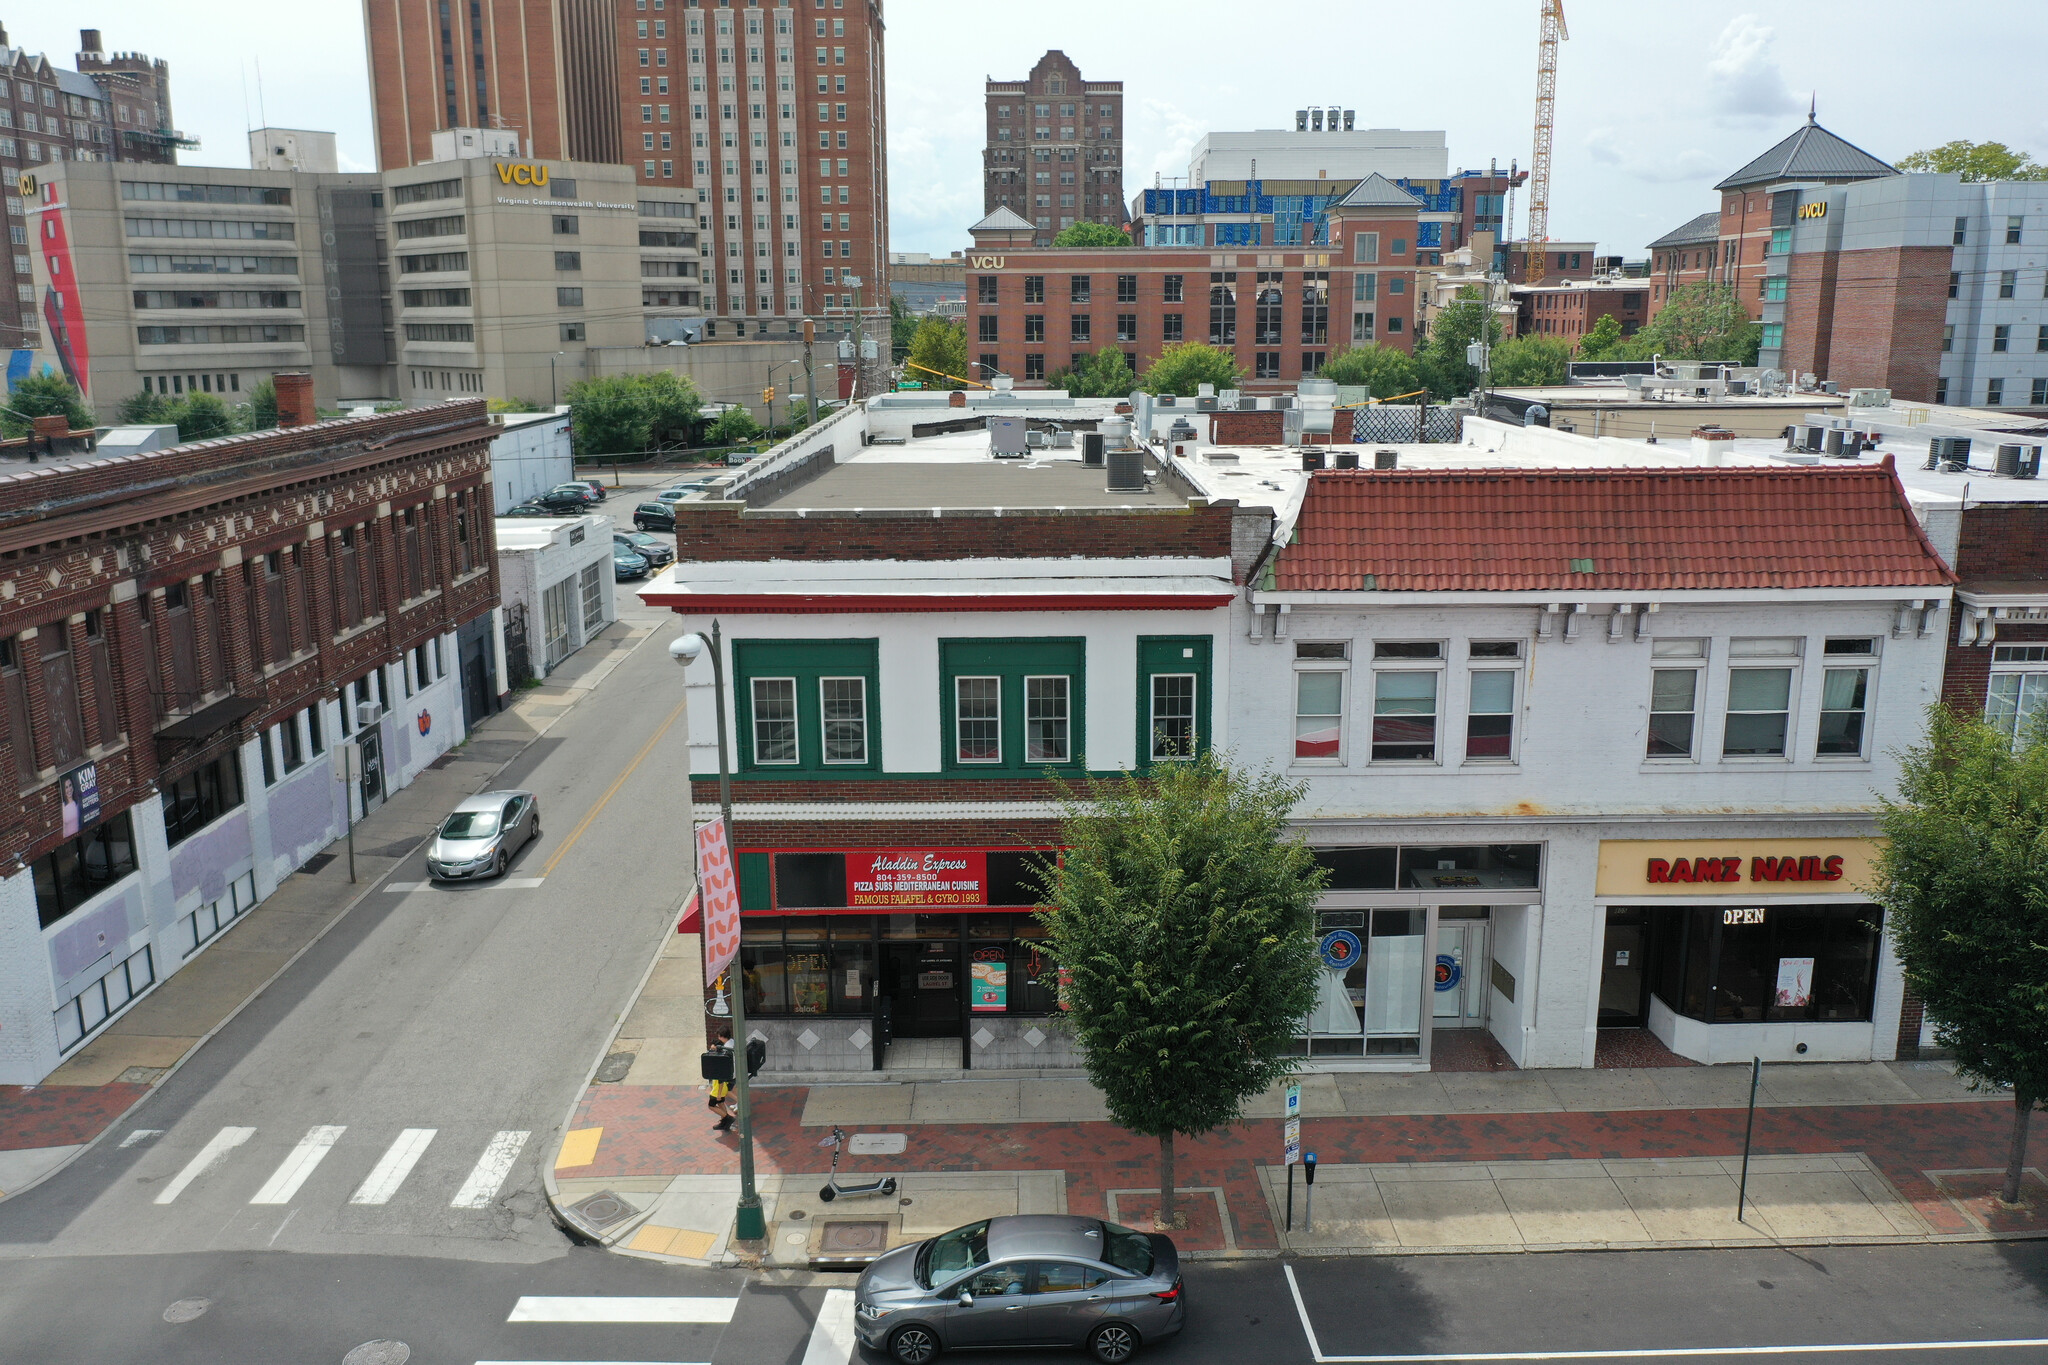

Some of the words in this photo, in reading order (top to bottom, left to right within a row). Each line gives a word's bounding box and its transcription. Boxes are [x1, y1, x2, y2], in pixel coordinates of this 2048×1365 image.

[496, 163, 549, 186] VCU
[18, 175, 35, 196] VCU
[497, 196, 529, 206] Virginia
[532, 198, 594, 208] Commonwealth
[596, 201, 635, 210] University
[1805, 202, 1826, 219] VCU
[971, 256, 1005, 269] VCU
[321, 206, 345, 355] HONORS
[78, 765, 96, 785] KIM
[80, 778, 97, 793] GRAY
[870, 855, 919, 873] Aladdin
[922, 853, 968, 873] Express
[1646, 857, 1742, 883] RAMZ
[1750, 855, 1844, 882] NAILS
[876, 873, 938, 881] 804-359-8500
[894, 881, 951, 891] MEDITERRANEAN
[951, 880, 979, 891] CUISINE
[854, 894, 888, 905] FAMOUS
[890, 894, 926, 904] FALAFEL
[927, 894, 934, 904] &
[935, 894, 960, 904] GYRO
[961, 893, 980, 904] 1993
[1723, 908, 1765, 925] OPEN
[973, 950, 1005, 960] OPEN
[795, 1005, 816, 1013] salad
